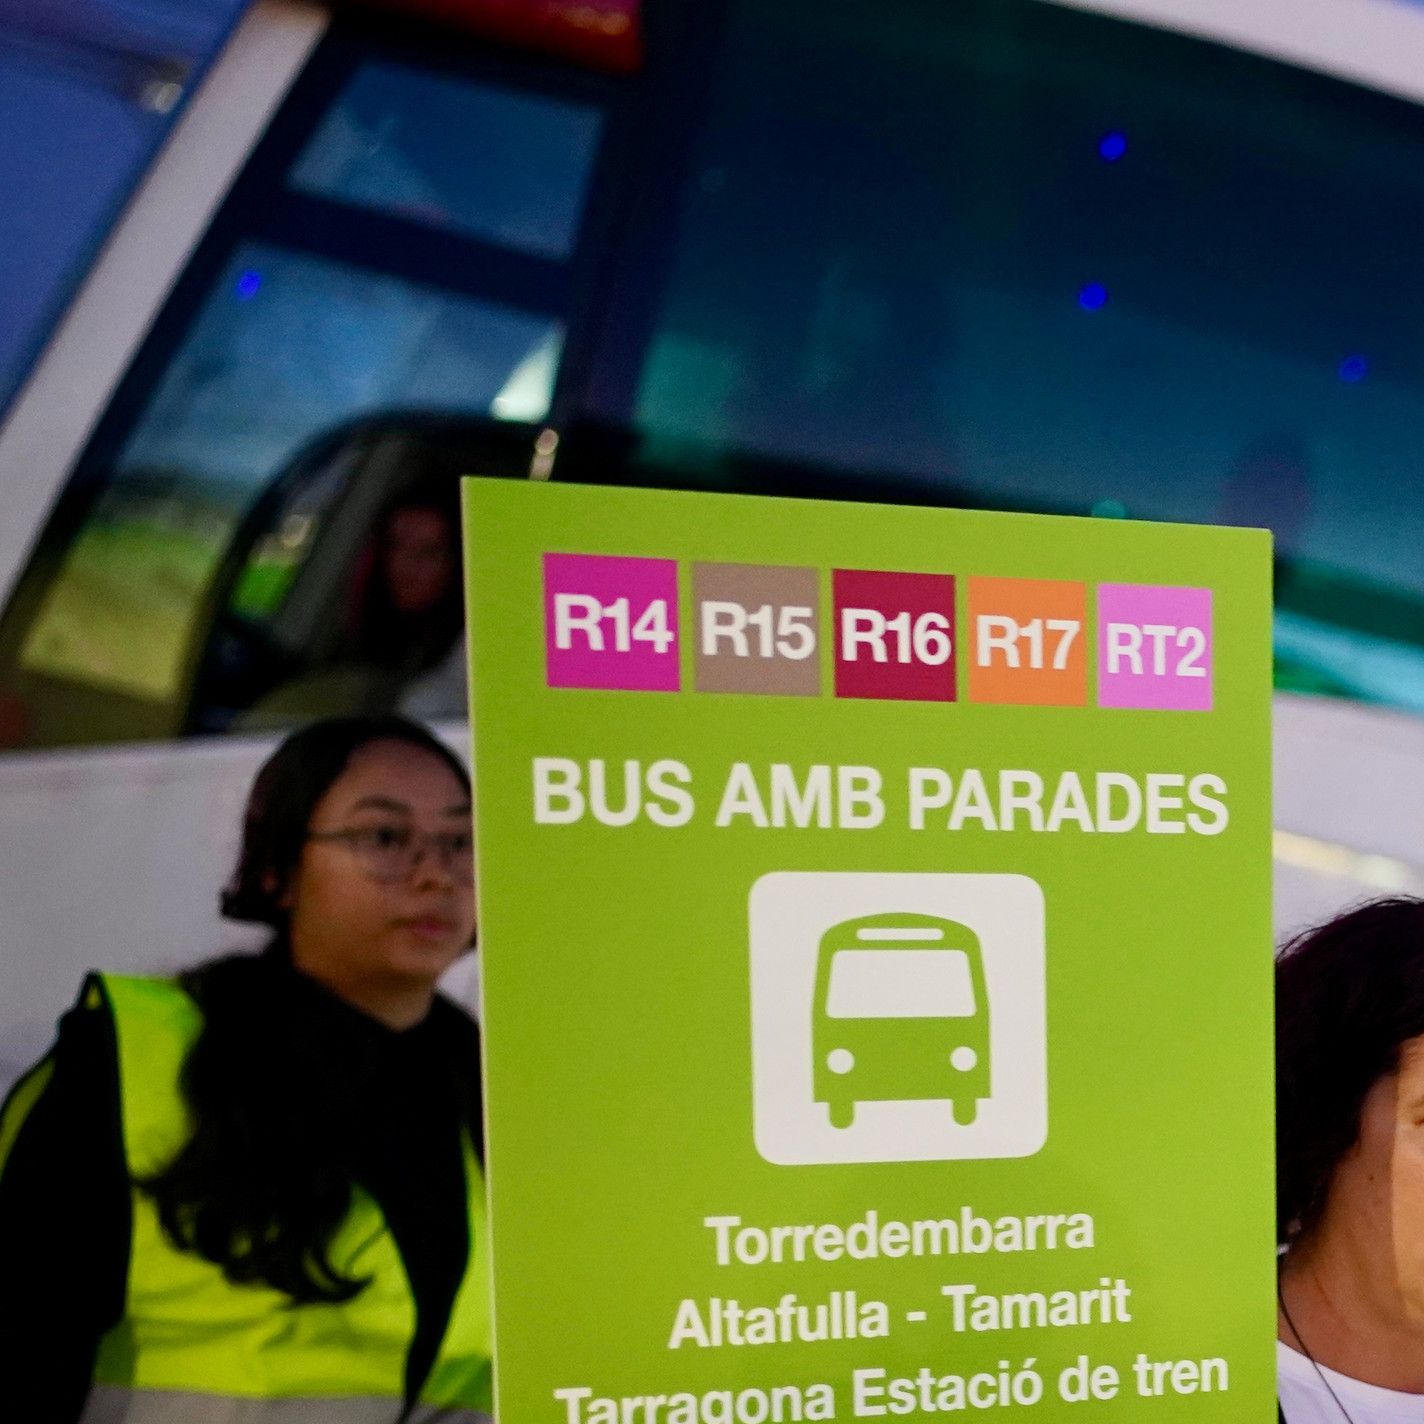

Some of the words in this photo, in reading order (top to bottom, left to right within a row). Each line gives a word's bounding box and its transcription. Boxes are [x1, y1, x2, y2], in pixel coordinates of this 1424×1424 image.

[553, 593, 675, 655] R14
[700, 599, 817, 661] R15
[842, 607, 952, 667] R16
[976, 615, 1081, 671] R17
[1106, 623, 1207, 678] RT2
[532, 757, 695, 828] BUS
[715, 762, 886, 831] AMB
[909, 767, 1229, 836] PARADES
[703, 1206, 1096, 1266] Torredembarra
[668, 1290, 890, 1350] Altafulla
[906, 1311, 928, 1322] -
[941, 1278, 1132, 1333] Tamarit
[853, 1358, 1042, 1416] Estació
[1058, 1354, 1120, 1402] de
[1133, 1354, 1229, 1397] tren
